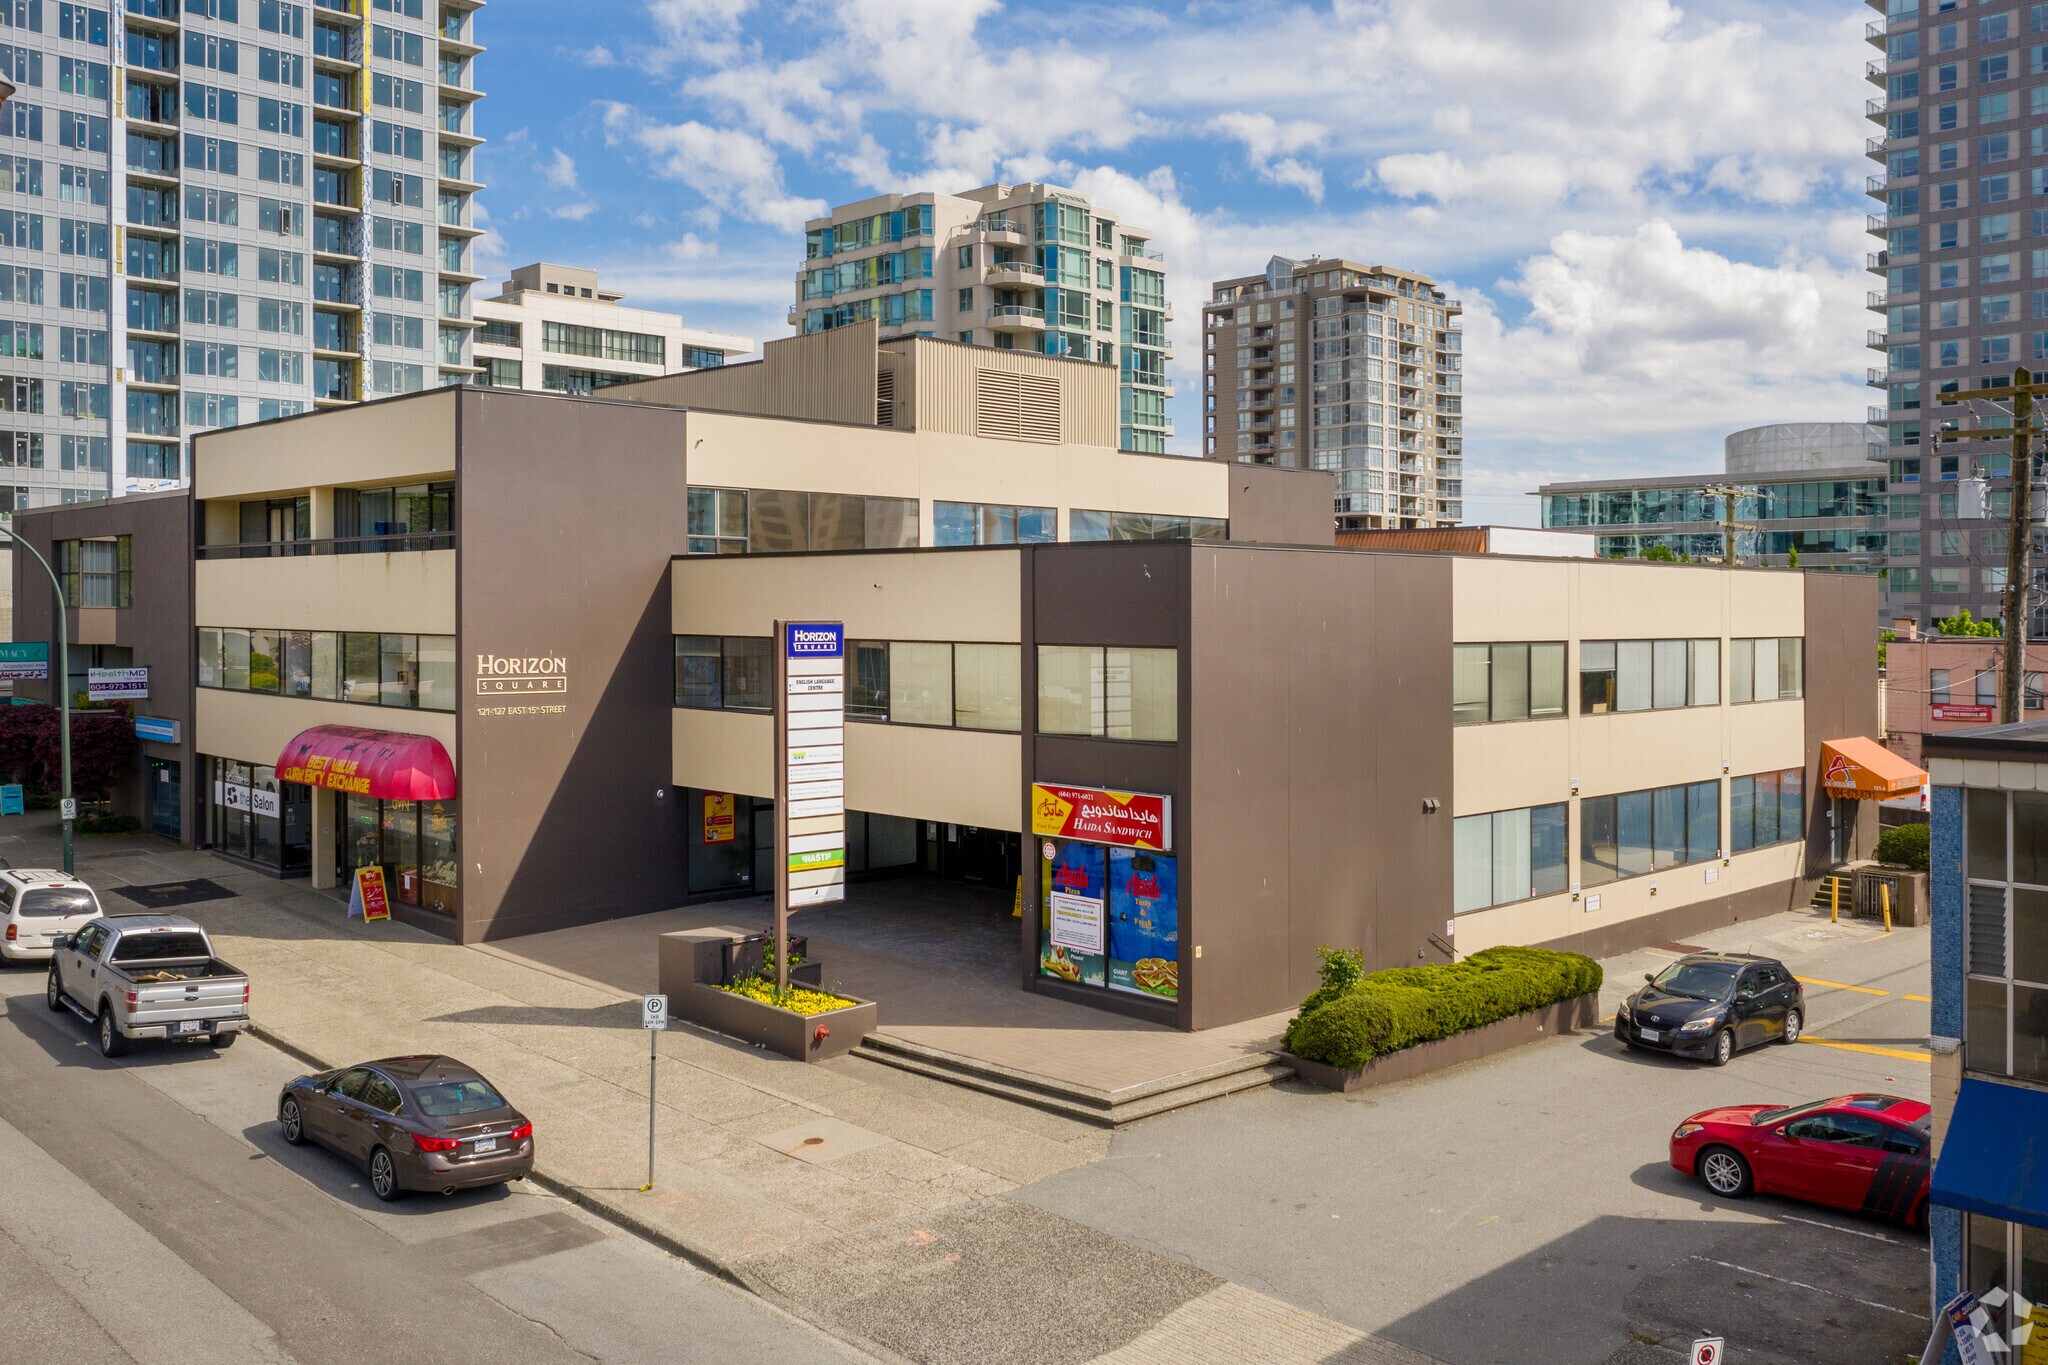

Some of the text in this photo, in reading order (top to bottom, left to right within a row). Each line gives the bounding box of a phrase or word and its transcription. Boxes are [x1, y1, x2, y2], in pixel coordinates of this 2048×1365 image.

[795, 630, 836, 641] HORIZON
[477, 654, 566, 674] HORIZON
[90, 683, 147, 691] 604-973-1511
[482, 681, 562, 690] SQUARE
[477, 707, 506, 716] 121-127
[508, 706, 527, 715] EAST
[540, 705, 566, 714] STREET
[307, 754, 359, 775] BEST VALUE
[284, 767, 371, 794] CURRENCY EXCHANGE
[1058, 791, 1071, 799] (604)
[254, 794, 274, 812] Salon
[1073, 818, 1152, 839] HAIDA SANDWICH
[1065, 886, 1080, 895] Pizza
[1135, 898, 1151, 907] Tasty
[1134, 917, 1152, 927] Fresh
[1113, 968, 1128, 976] GIANT
